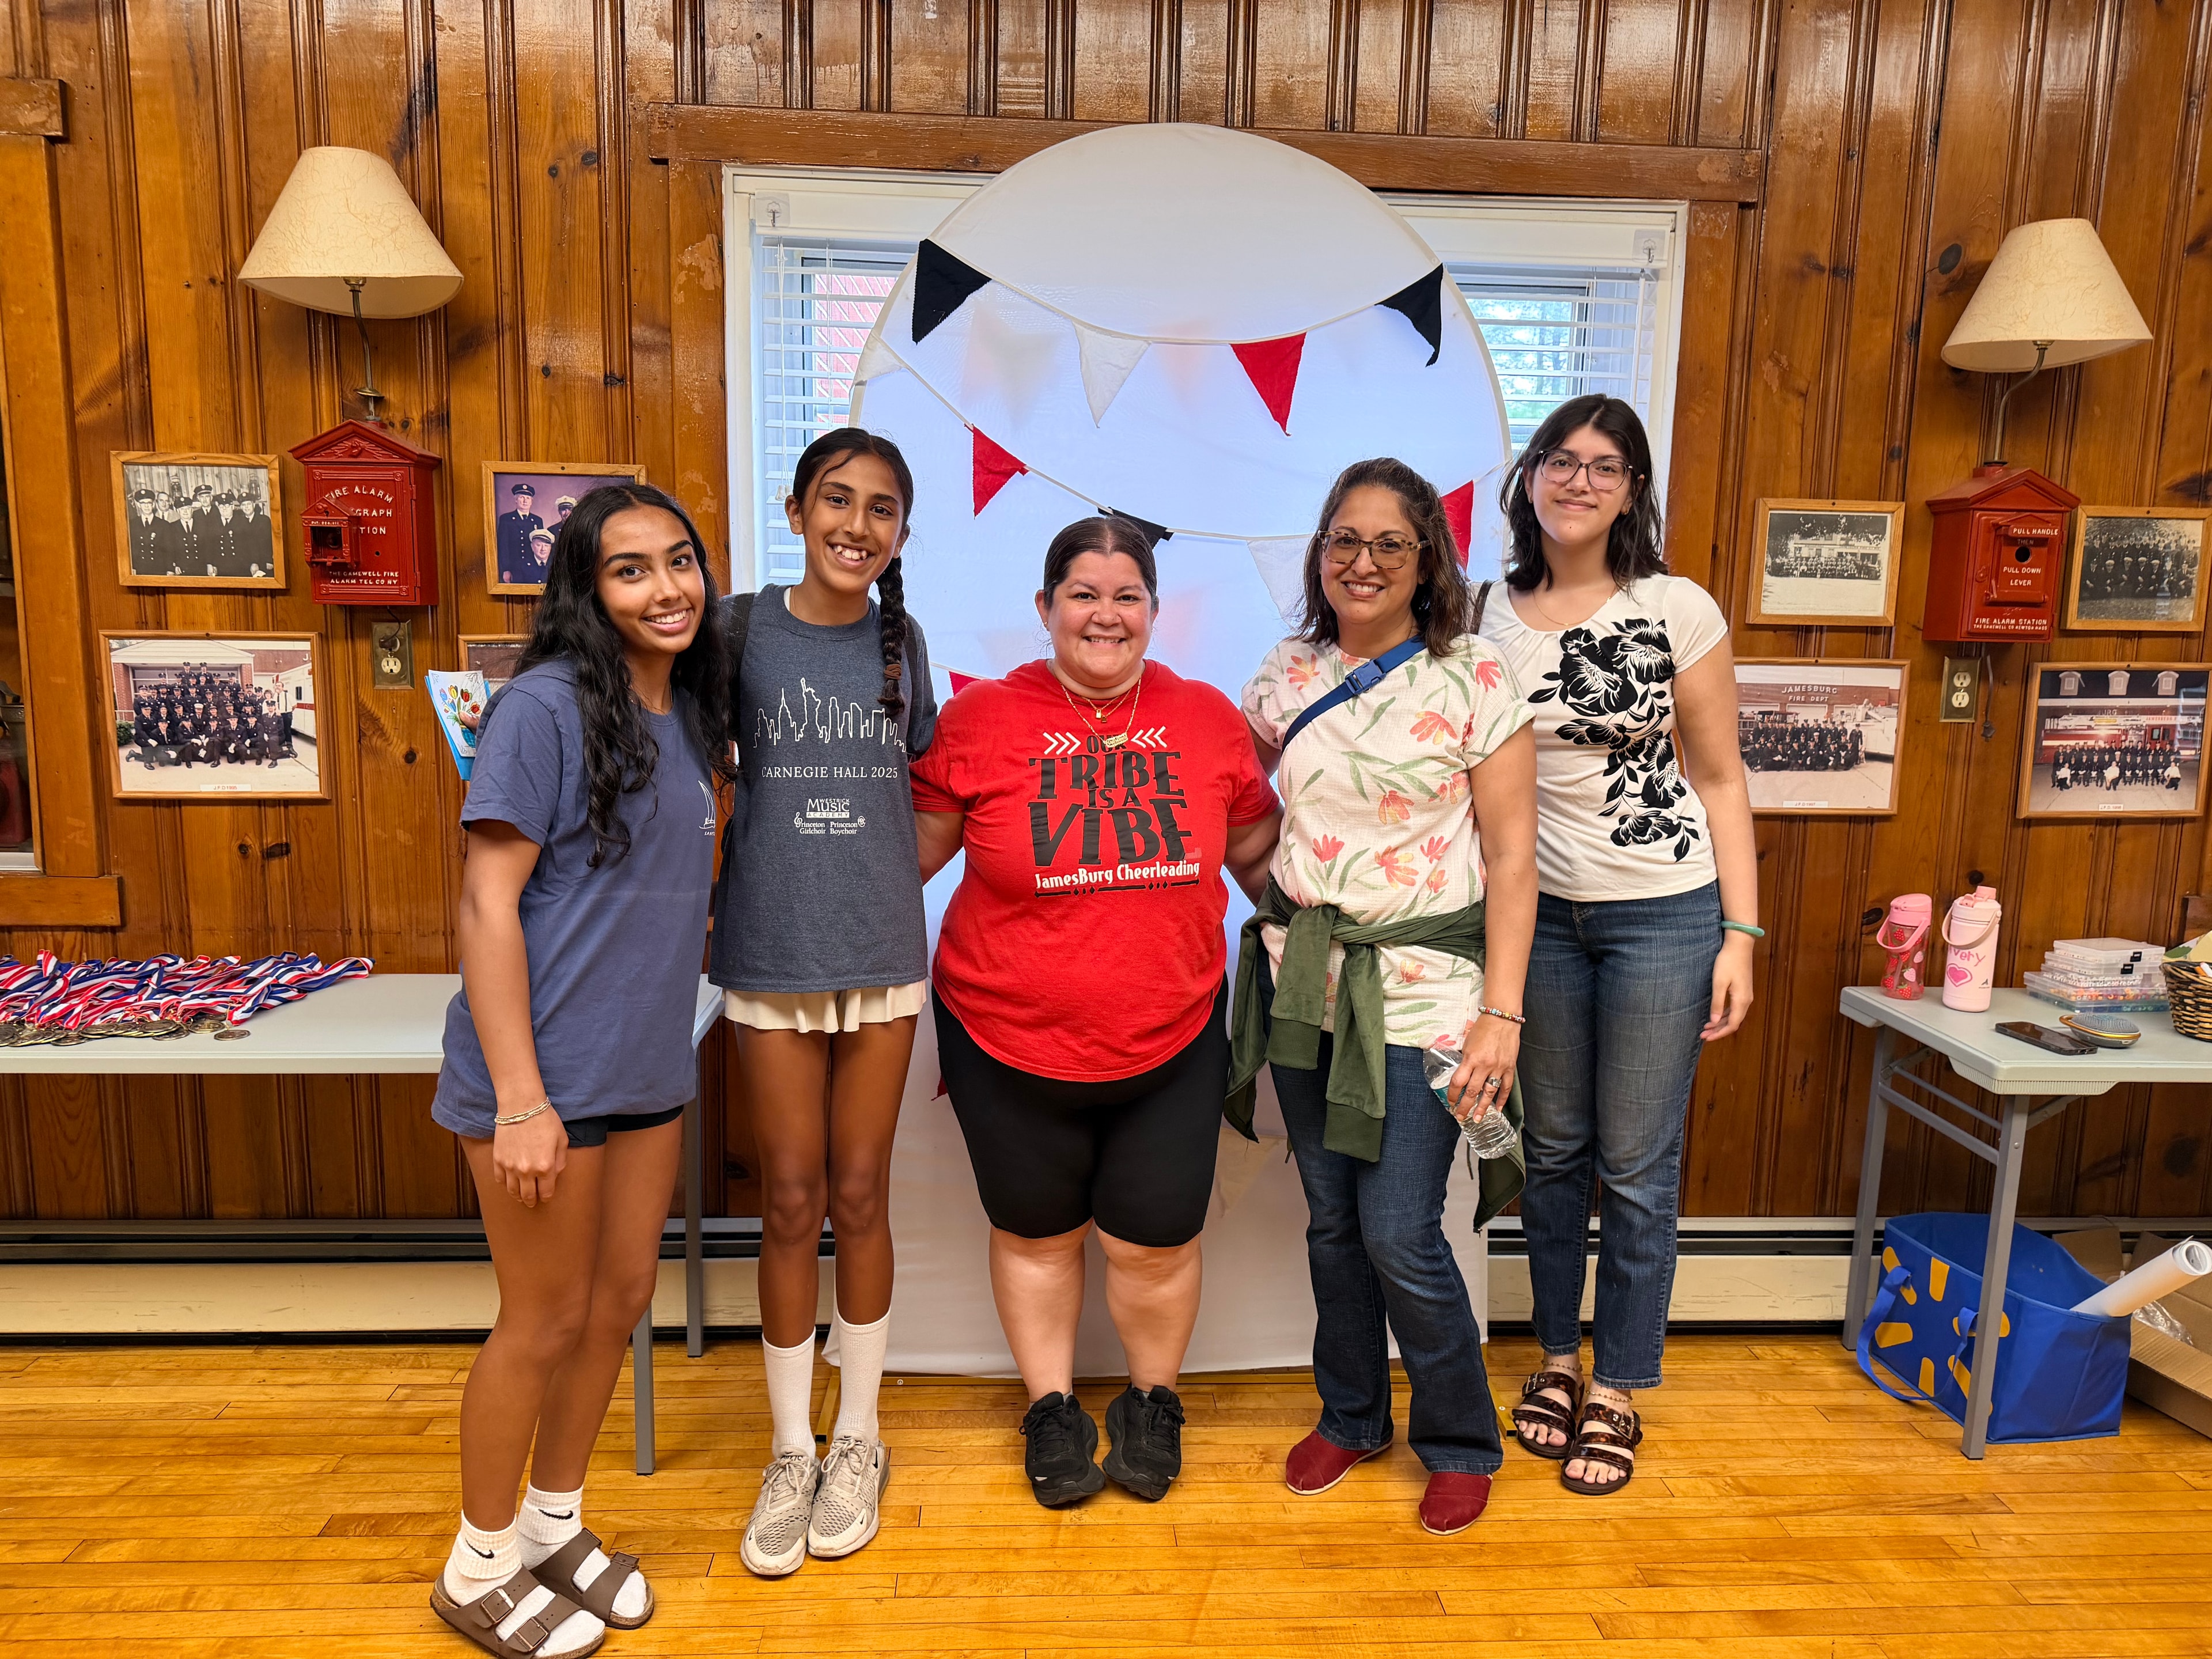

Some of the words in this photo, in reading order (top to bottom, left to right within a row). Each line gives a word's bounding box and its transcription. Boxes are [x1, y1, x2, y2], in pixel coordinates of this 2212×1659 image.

[354, 486, 394, 503] ALARM
[1782, 685, 1838, 694] JAMESBURG
[762, 766, 828, 778] CARNEGIE
[834, 767, 868, 778] HALL
[871, 766, 898, 778] 2025
[1028, 751, 1184, 800] TRIBE
[1088, 789, 1115, 808] IS
[1122, 788, 1142, 807] A
[830, 828, 857, 836] Boychoir
[1027, 798, 1193, 867] VIBE
[1035, 868, 1113, 889] JamesBurg
[1116, 861, 1200, 881] Cheerleading
